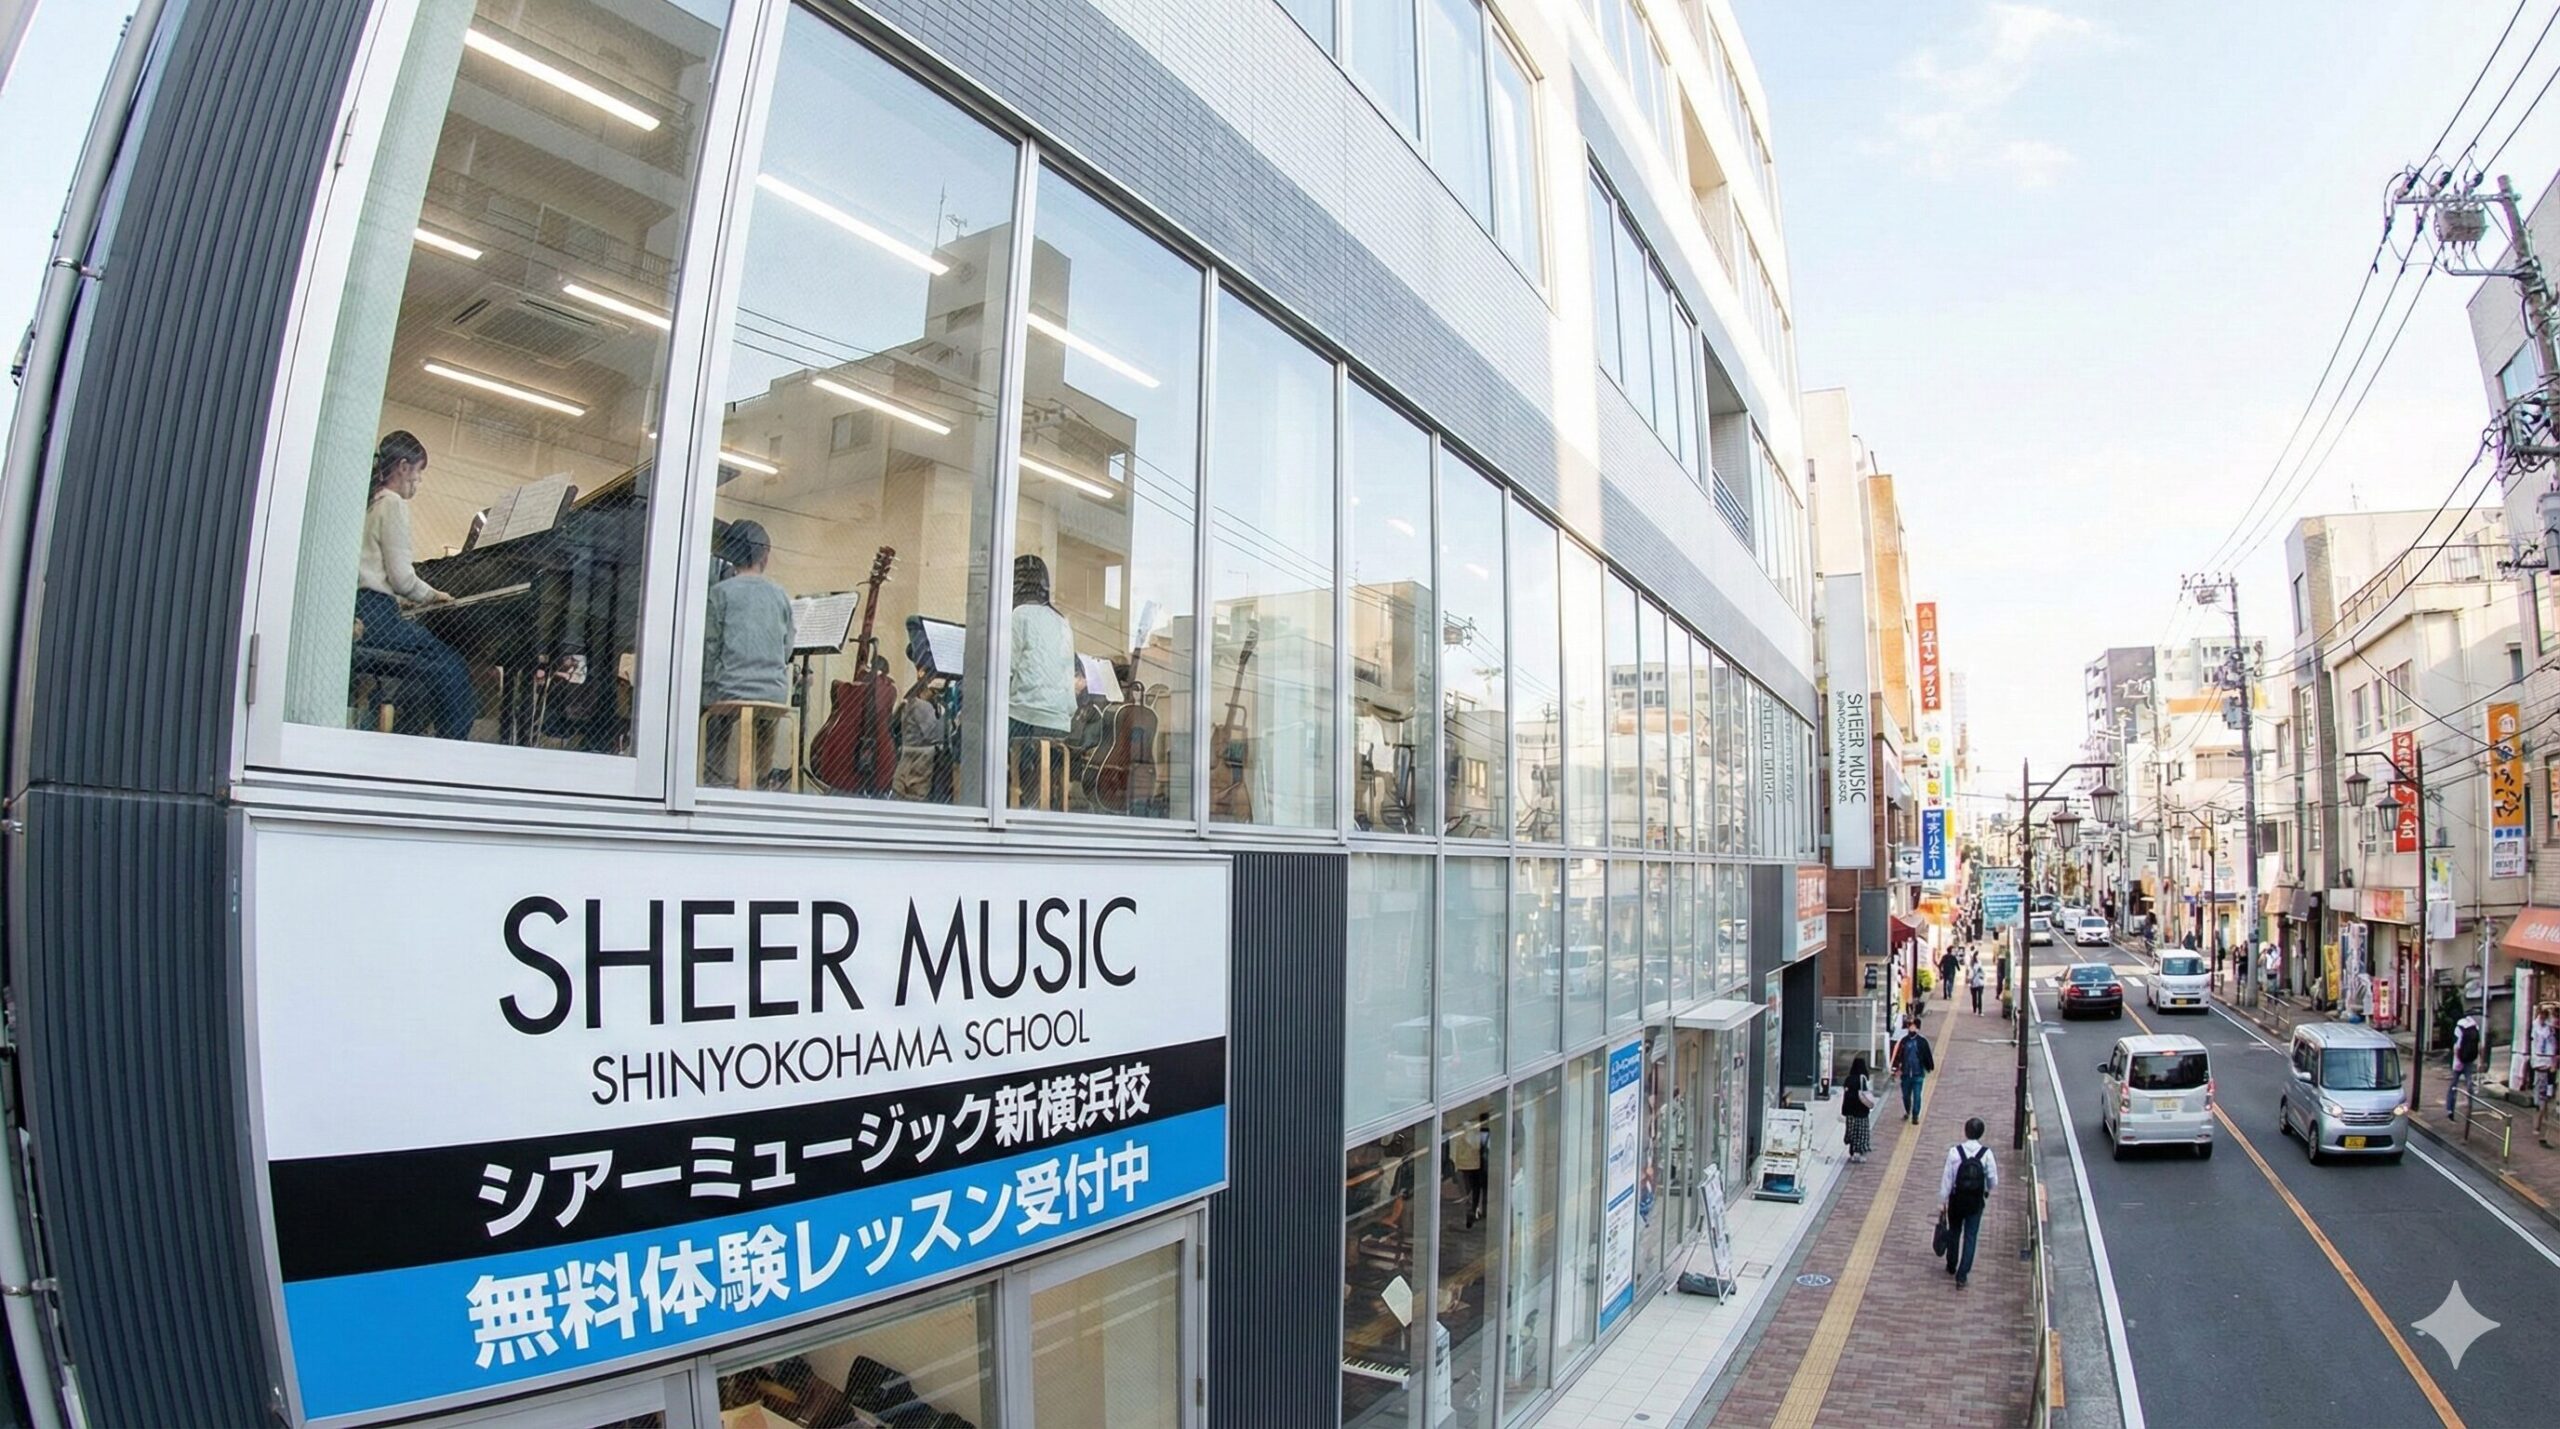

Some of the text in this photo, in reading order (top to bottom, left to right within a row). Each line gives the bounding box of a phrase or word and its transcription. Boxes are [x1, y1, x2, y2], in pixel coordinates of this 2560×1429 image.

[1847, 693, 1867, 804] SHEER MUSIC
[500, 895, 1137, 1036] SHEER MUSIC
[591, 1008, 1090, 1106] SHINYOKOHAMA SCHOOL
[478, 1061, 1151, 1237] シアーミュージック新横浜校
[466, 1140, 1150, 1369] 無料体験レッスン受付中
